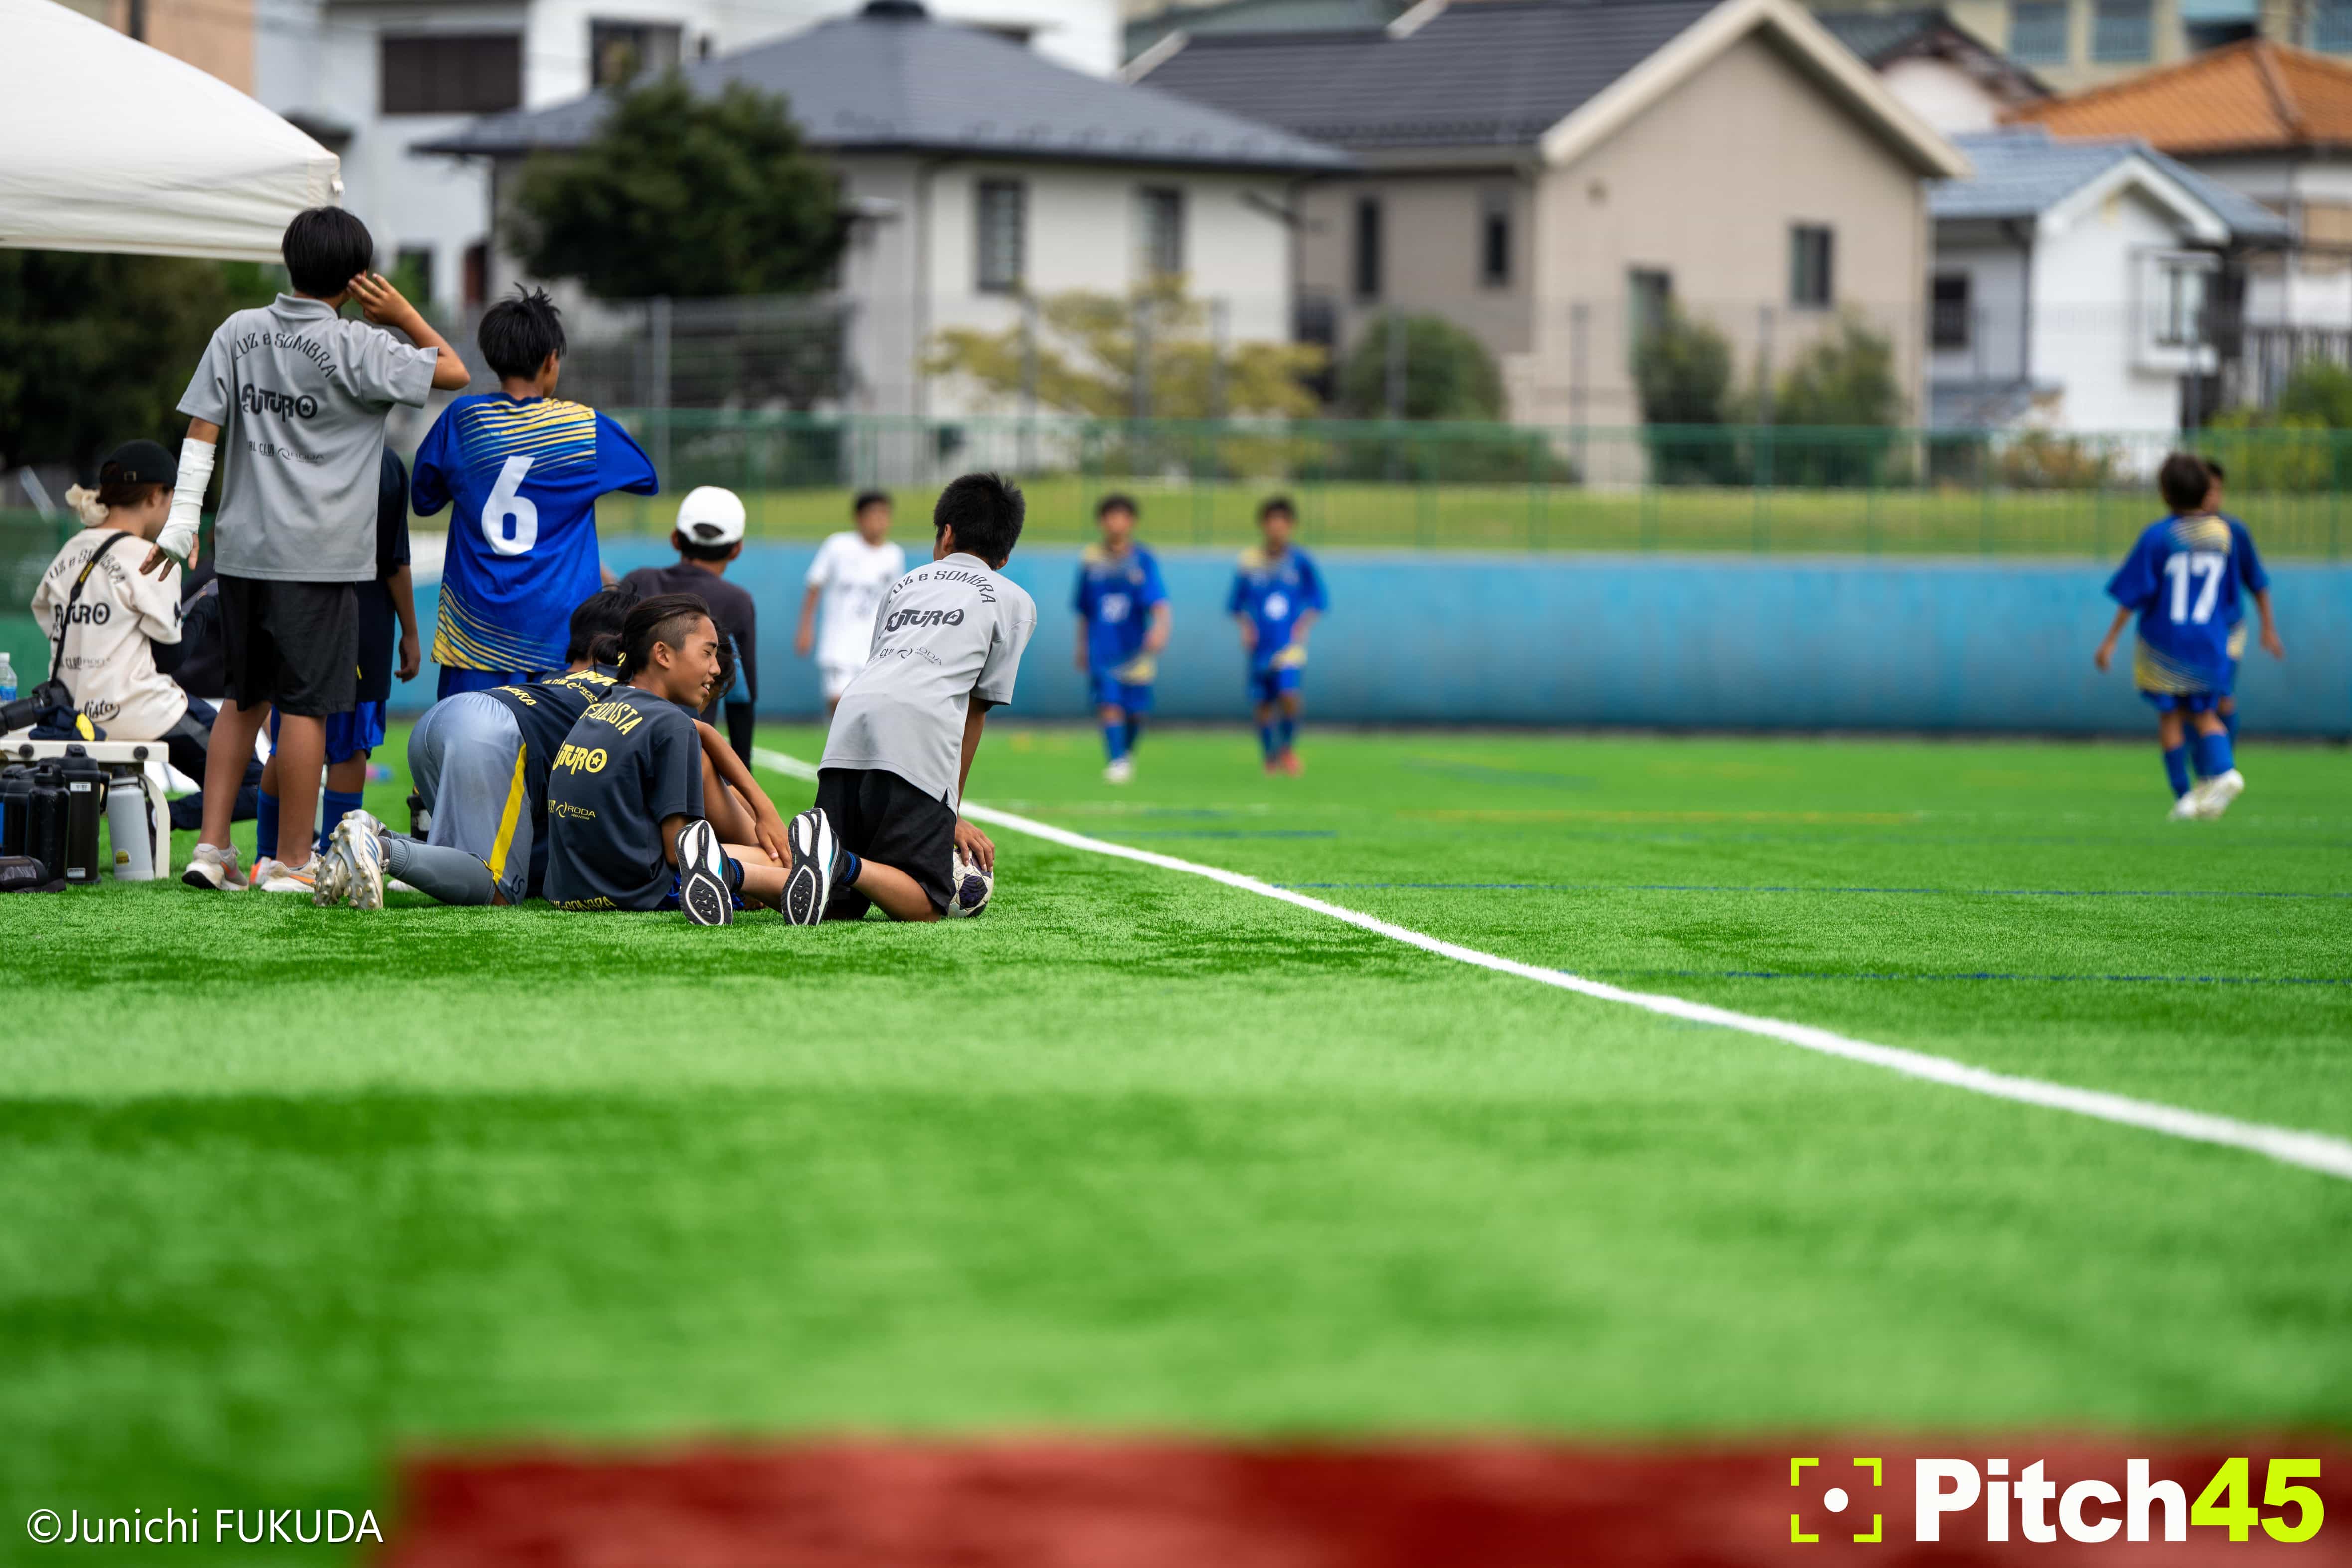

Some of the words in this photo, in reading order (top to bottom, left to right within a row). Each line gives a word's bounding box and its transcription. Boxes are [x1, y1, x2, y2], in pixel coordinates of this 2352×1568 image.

[275, 332, 337, 378] SOMBRA
[241, 382, 318, 423] FUTURO
[481, 455, 538, 556] 6
[934, 570, 996, 603] SOMBRA
[2165, 553, 2227, 623] 17
[917, 647, 941, 666] ODA
[552, 741, 608, 775] UTURO
[568, 805, 596, 818] RODA
